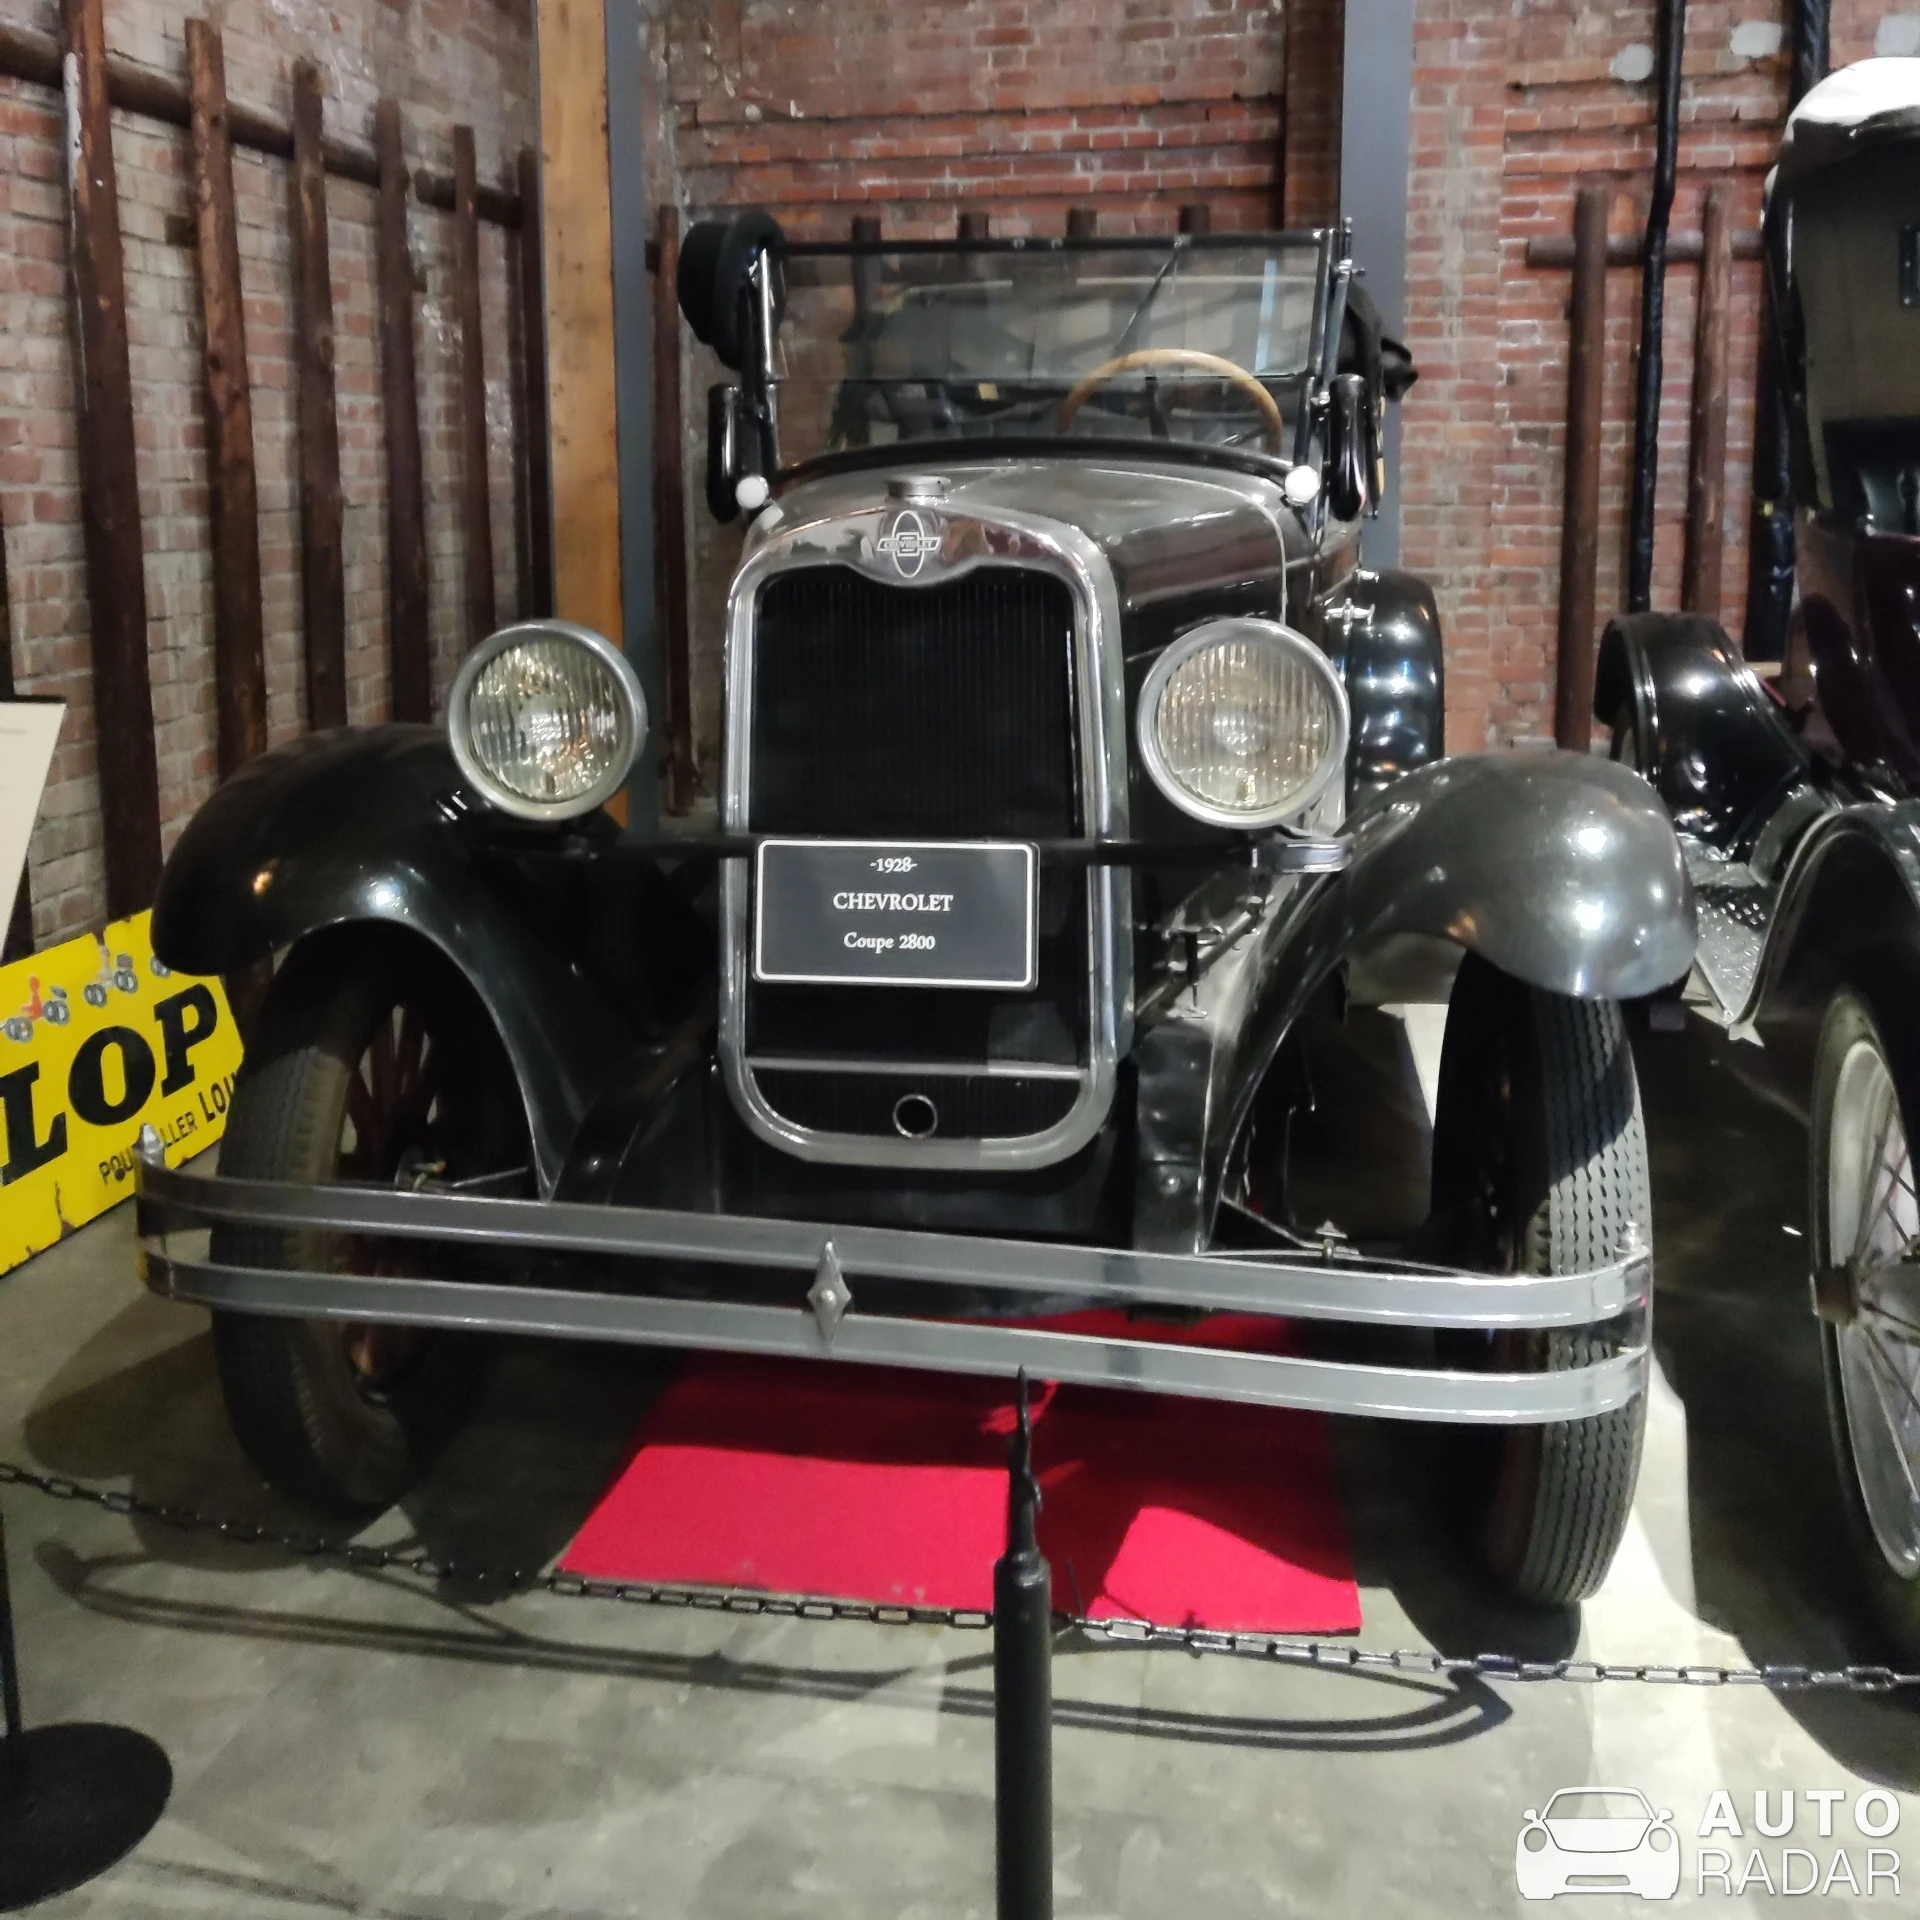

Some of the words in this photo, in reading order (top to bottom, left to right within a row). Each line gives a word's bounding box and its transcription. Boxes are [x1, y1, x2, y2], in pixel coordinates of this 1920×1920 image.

[869, 856, 918, 873] -1928-
[833, 892, 954, 912] CHEVROLET
[843, 932, 895, 954] Coupe
[898, 934, 936, 950] 2800
[98, 1146, 134, 1185] POU
[159, 1111, 199, 1149] LLER
[197, 1072, 237, 1123] LOI
